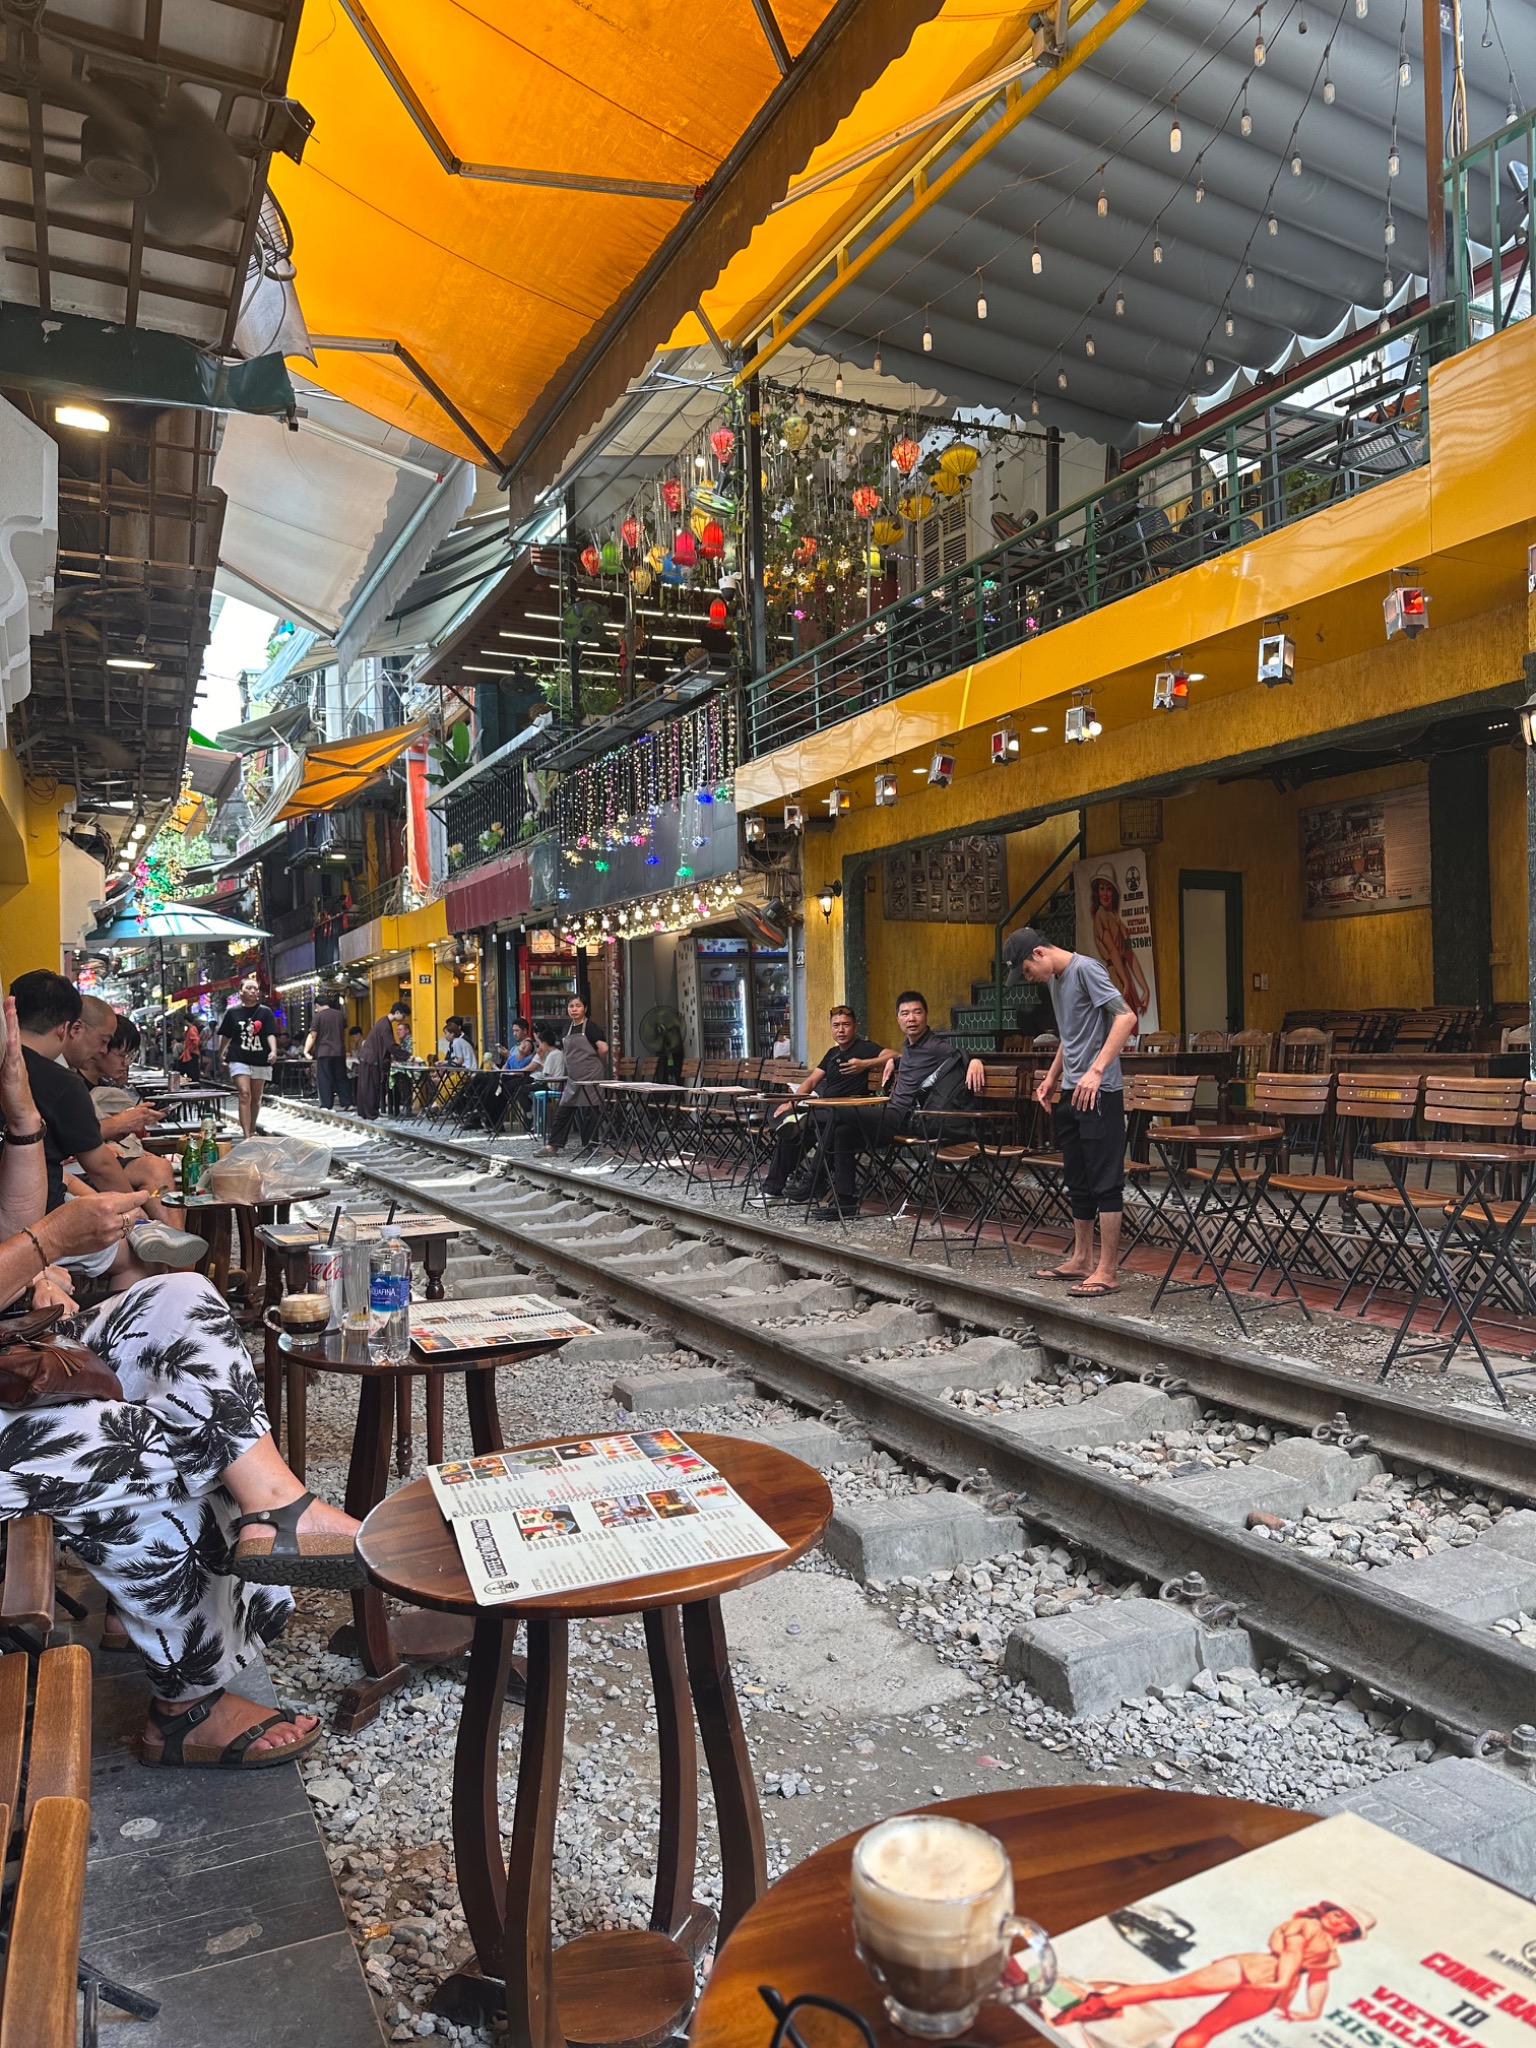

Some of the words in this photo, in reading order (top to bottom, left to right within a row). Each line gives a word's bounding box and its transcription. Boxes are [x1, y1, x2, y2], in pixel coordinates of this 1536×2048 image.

[420, 975, 430, 983] 37
[1420, 1951, 1506, 2000] COME
[1446, 1999, 1490, 2028] TO
